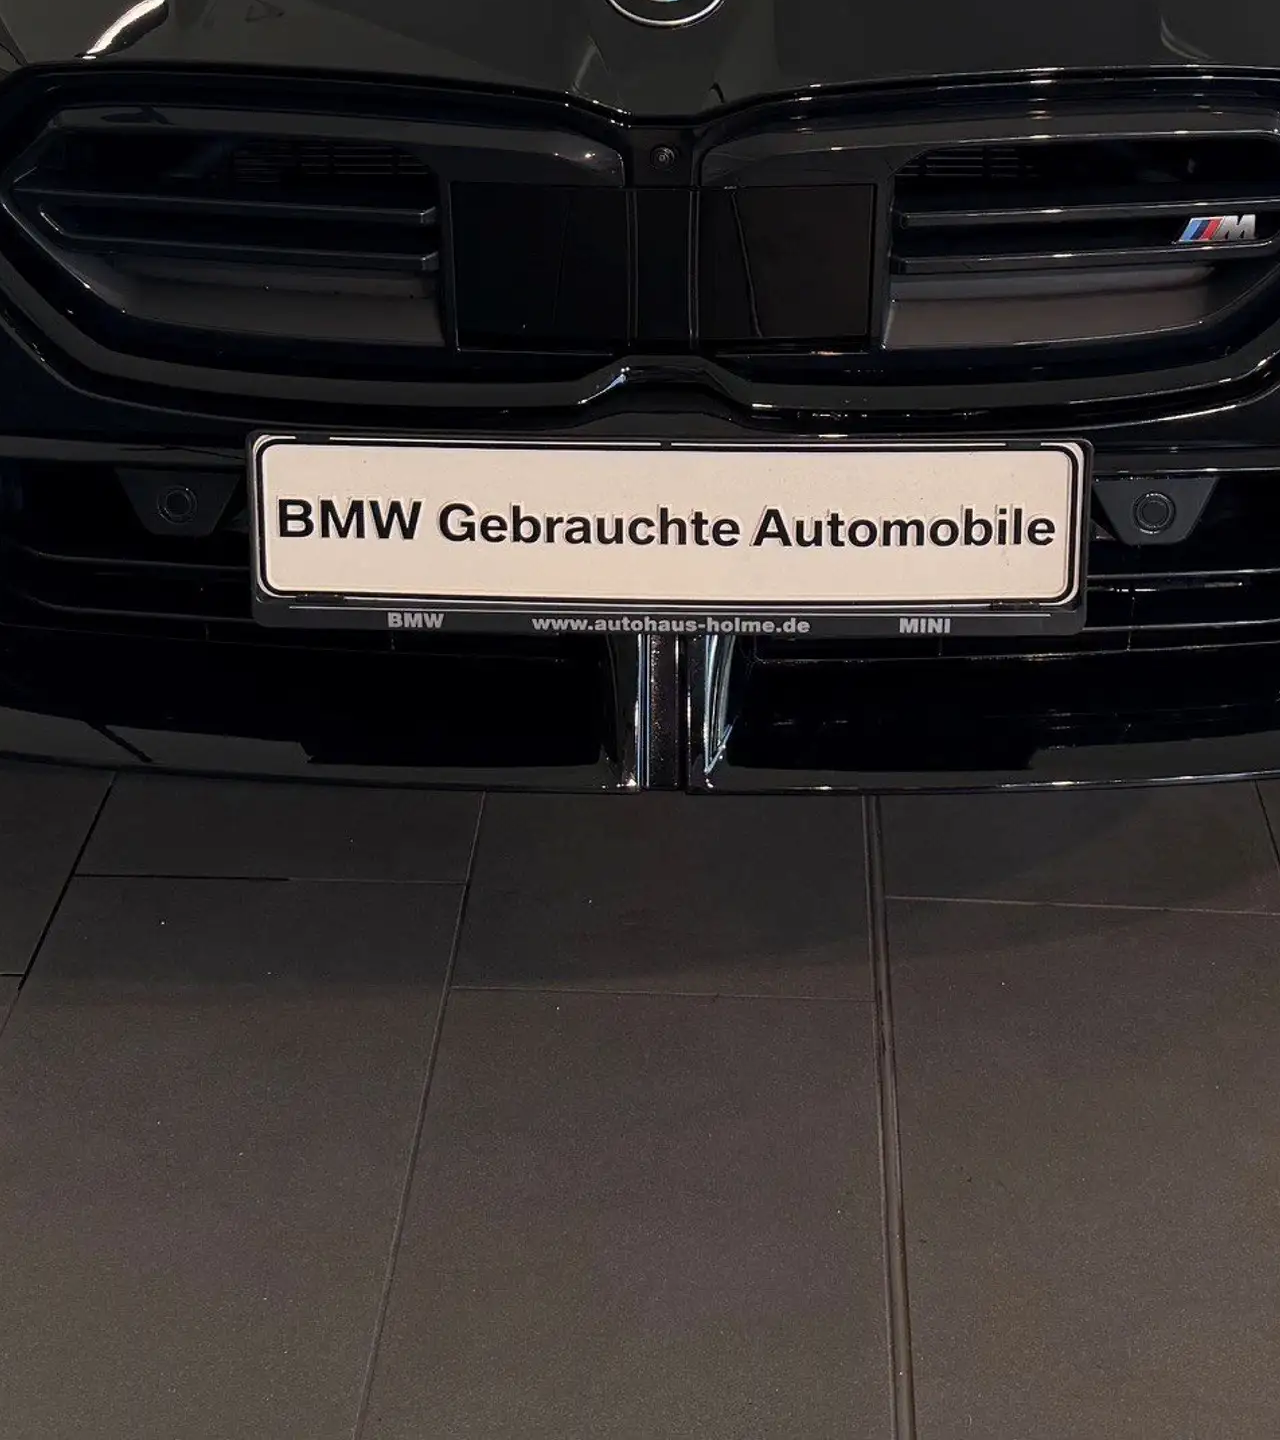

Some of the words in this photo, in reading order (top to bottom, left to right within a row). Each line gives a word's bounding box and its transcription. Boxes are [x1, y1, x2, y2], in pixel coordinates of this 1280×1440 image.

[278, 499, 422, 539] BMW
[439, 503, 741, 545] Gebrauchte
[752, 507, 1055, 547] Automobile
[387, 611, 444, 628] BMW
[532, 616, 811, 634] www.autohaus-holme.de
[899, 618, 951, 634] MINI
